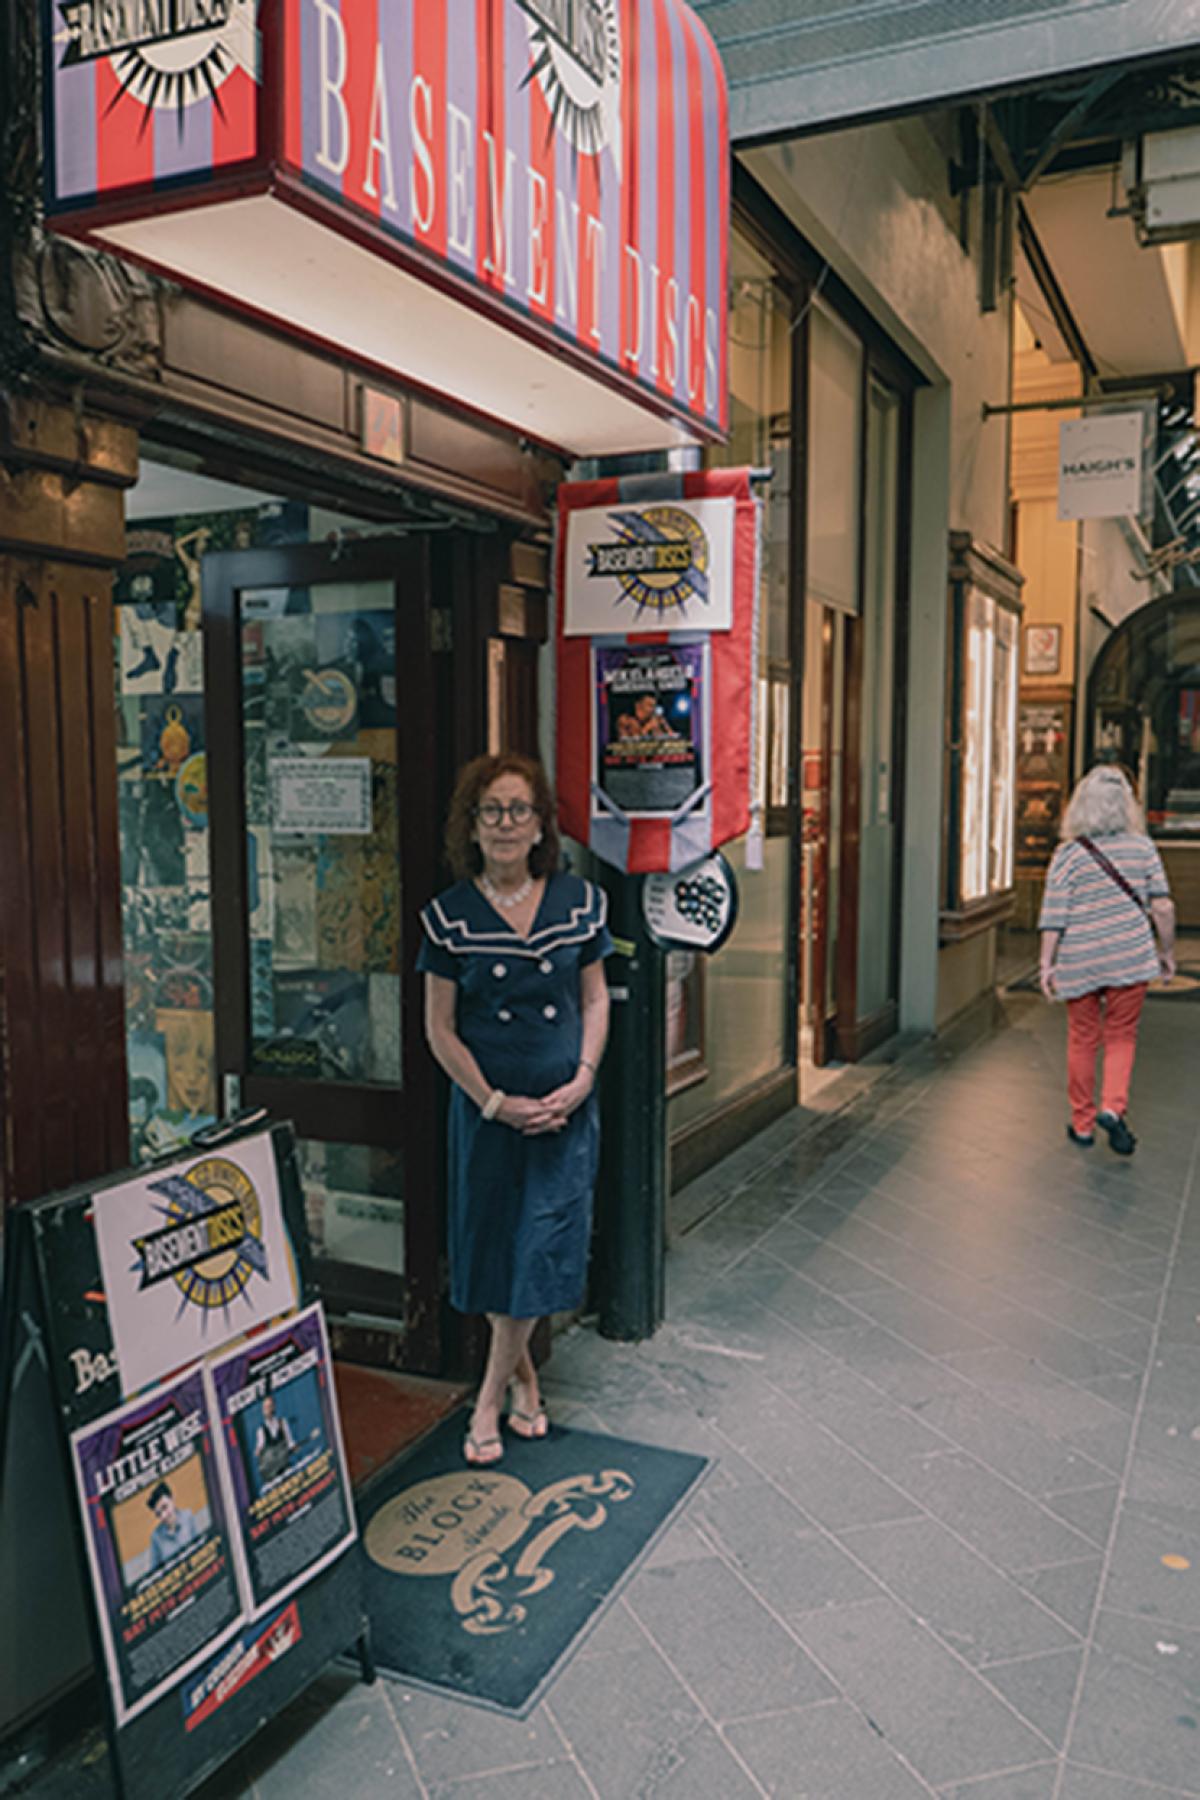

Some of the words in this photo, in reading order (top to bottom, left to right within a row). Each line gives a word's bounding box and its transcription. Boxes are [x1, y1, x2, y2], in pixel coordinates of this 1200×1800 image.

[314, 0, 606, 339] BASEMENT
[625, 244, 718, 411] DISCS
[1062, 457, 1136, 475] HAIGH'S
[597, 547, 656, 571] BASEMENT
[656, 545, 688, 569] DISCS
[145, 1221, 208, 1276] BASEMENT
[208, 1205, 244, 1250] DISCS
[95, 1439, 162, 1495] LITTLE
[163, 1409, 204, 1452] WISE
[395, 1479, 500, 1562] BLOCK
